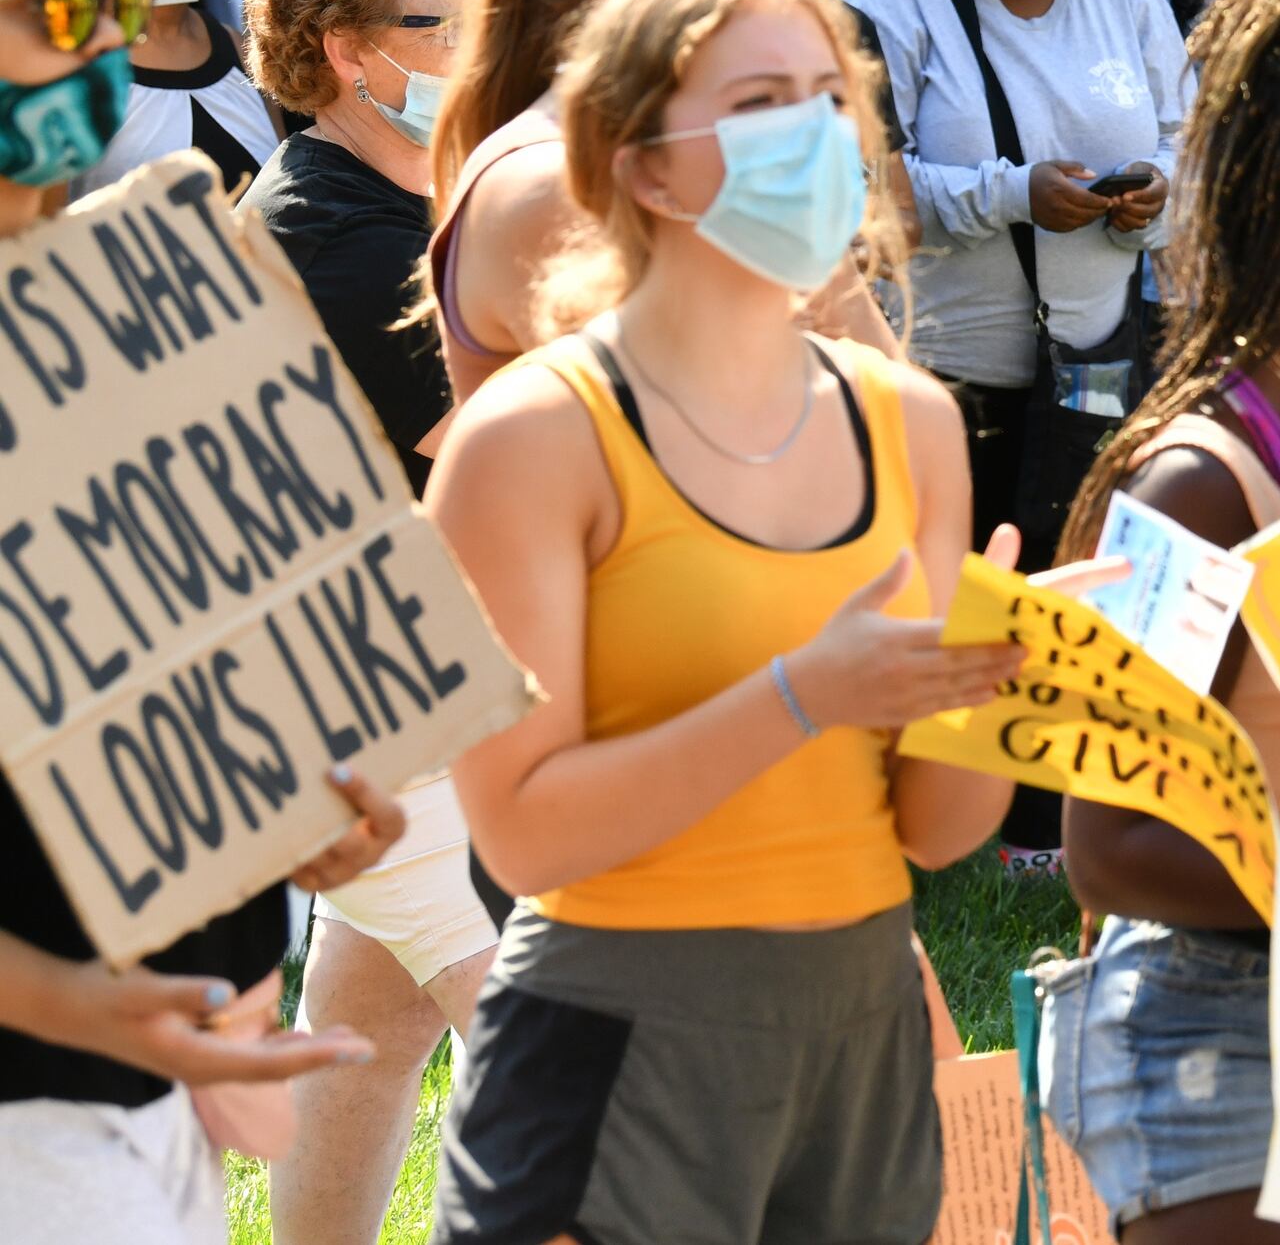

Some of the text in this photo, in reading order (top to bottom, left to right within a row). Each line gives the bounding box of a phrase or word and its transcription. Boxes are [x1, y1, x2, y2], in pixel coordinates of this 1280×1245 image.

[0, 171, 264, 407] IS WHAT
[0, 343, 386, 729] DEMOCRACY
[50, 532, 468, 917] LOOKS LIKE
